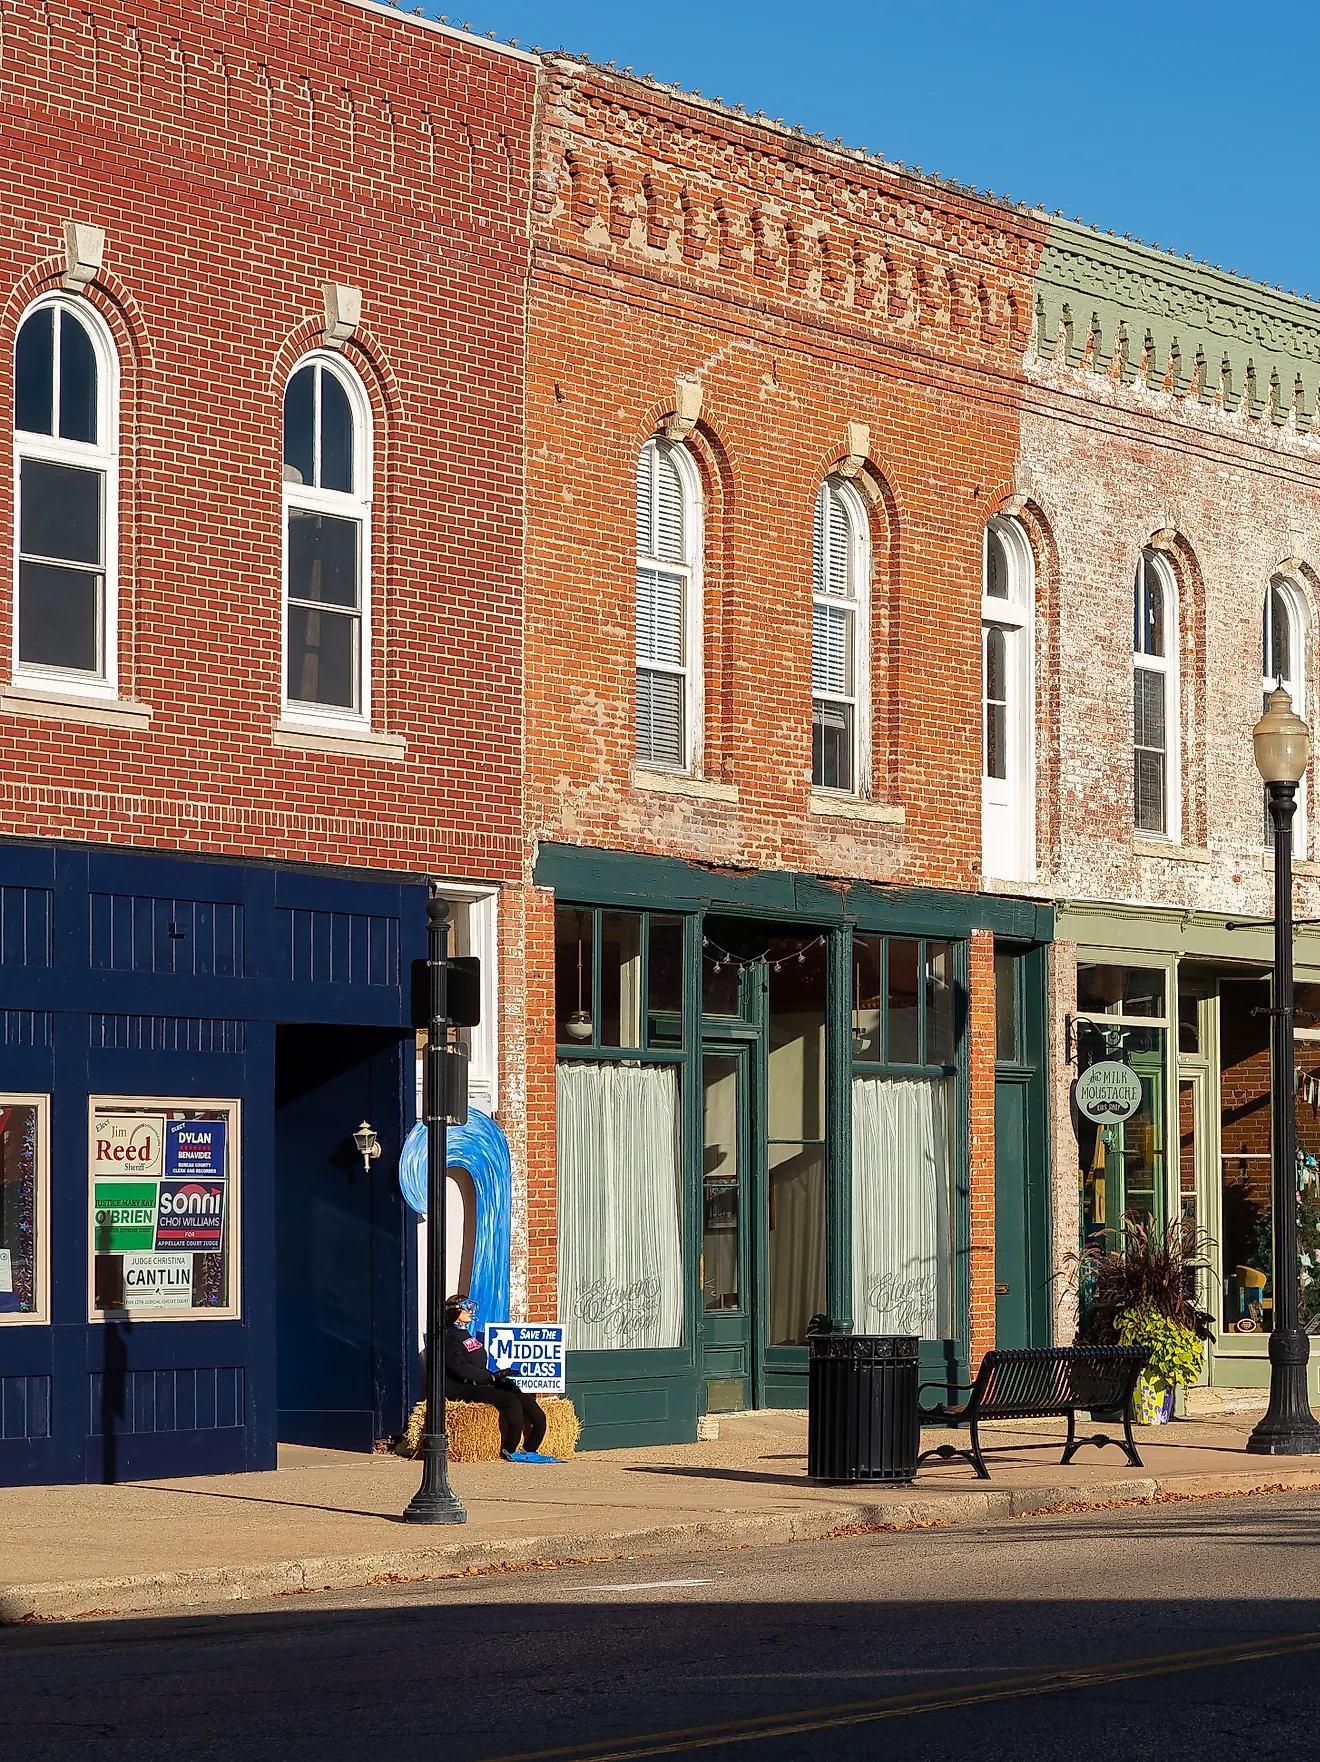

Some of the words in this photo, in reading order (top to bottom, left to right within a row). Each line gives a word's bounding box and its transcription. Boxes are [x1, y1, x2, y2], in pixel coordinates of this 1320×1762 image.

[1103, 1071, 1127, 1084] MILK
[1081, 1086, 1138, 1101] MOUSTACHE
[96, 1119, 110, 1132] Elect
[171, 1122, 186, 1133] ELECT
[112, 1126, 127, 1138] Jim
[179, 1132, 212, 1144] DYLAN
[95, 1139, 152, 1161] Reed
[178, 1151, 212, 1159] BENAVIDEZ
[124, 1163, 145, 1171] Sheriff
[95, 1199, 121, 1207] JUSTICE
[122, 1199, 140, 1207] MARY
[141, 1199, 154, 1207] KAY
[95, 1209, 153, 1225] O'BRIEN
[160, 1217, 181, 1226] CHOI
[182, 1217, 220, 1226] WILLIAMS
[131, 1257, 152, 1266] JUDGE
[153, 1256, 186, 1265] CHRISTINA
[126, 1268, 190, 1286] CANTLIN
[520, 1328, 540, 1340] SAVE
[541, 1328, 557, 1340] THE
[497, 1340, 561, 1359] MIDDLE
[520, 1362, 557, 1377] CLASS
